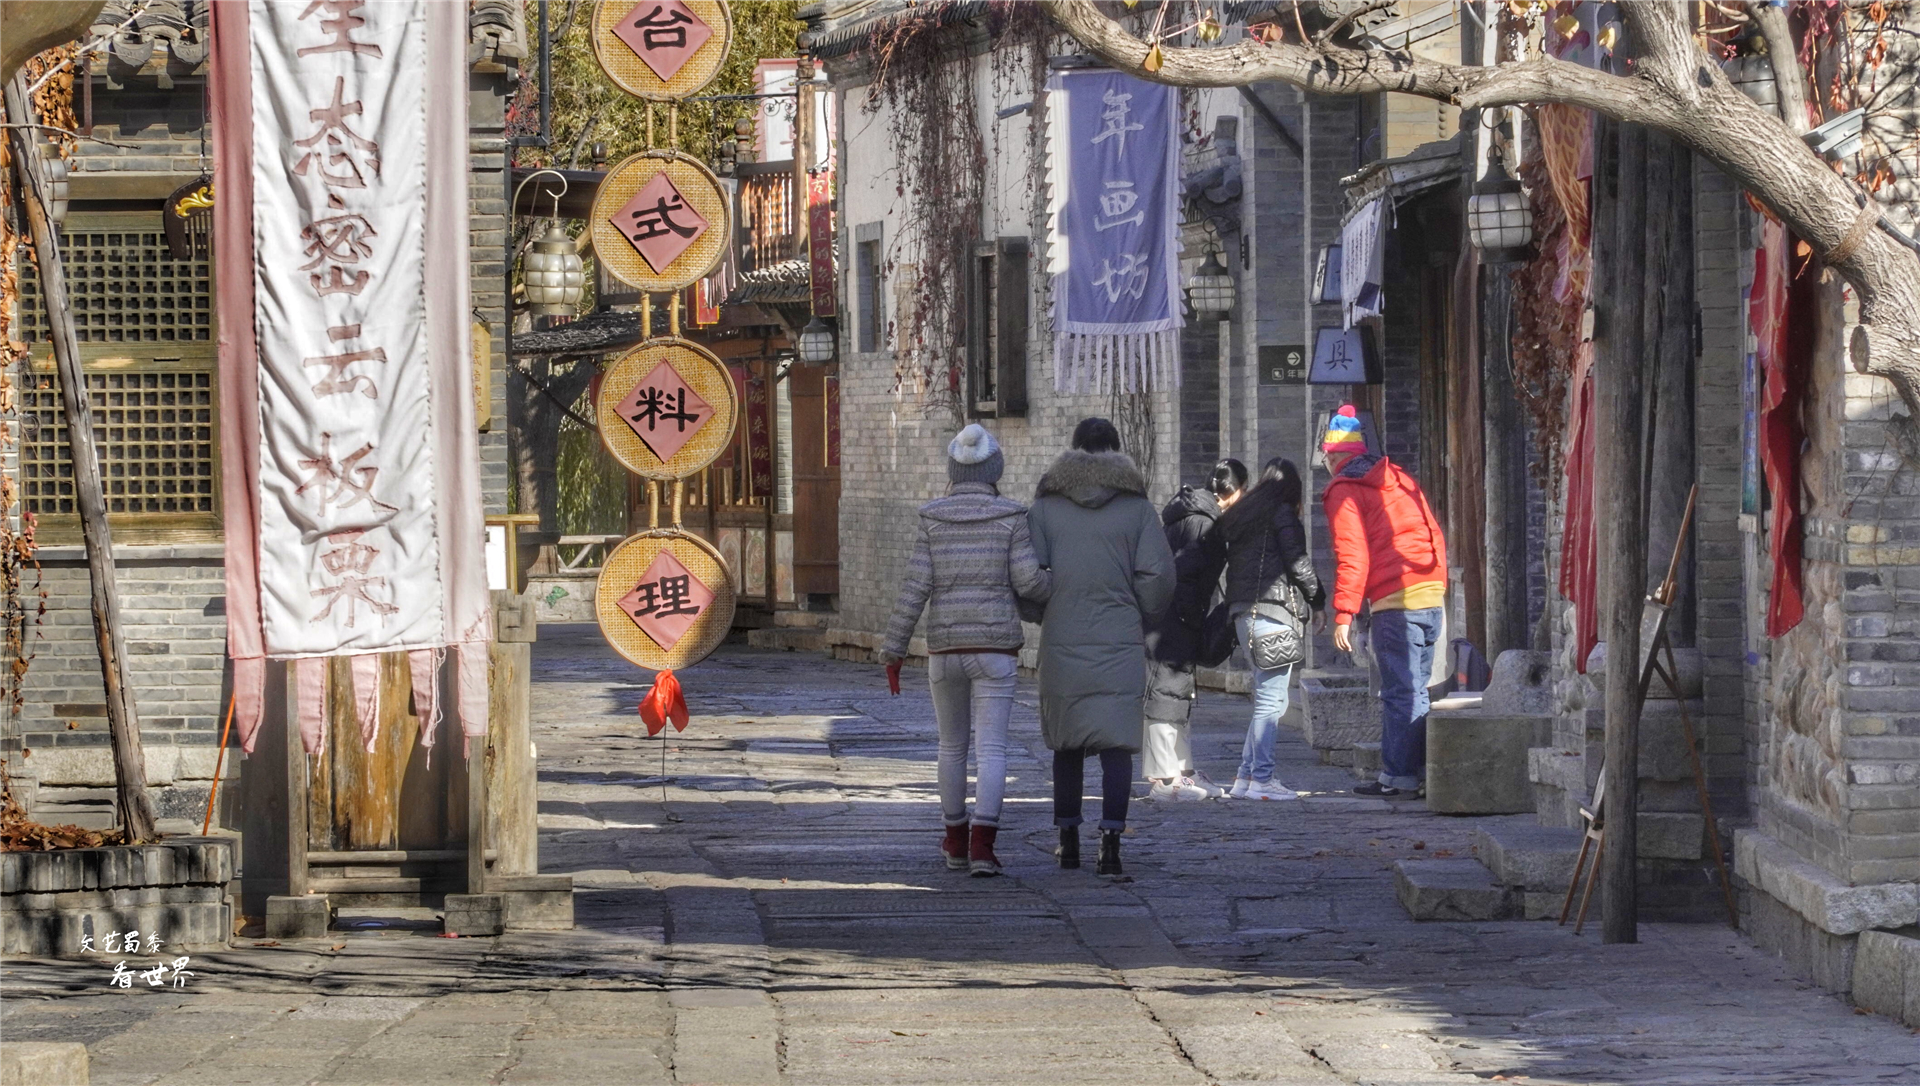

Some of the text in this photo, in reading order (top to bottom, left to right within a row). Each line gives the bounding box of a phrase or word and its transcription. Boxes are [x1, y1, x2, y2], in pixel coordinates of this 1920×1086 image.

[293, 0, 400, 628] 生态密云板栗
[632, 5, 700, 619] 台式料理
[1091, 88, 1149, 303] 年画坊
[1324, 339, 1353, 371] 具
